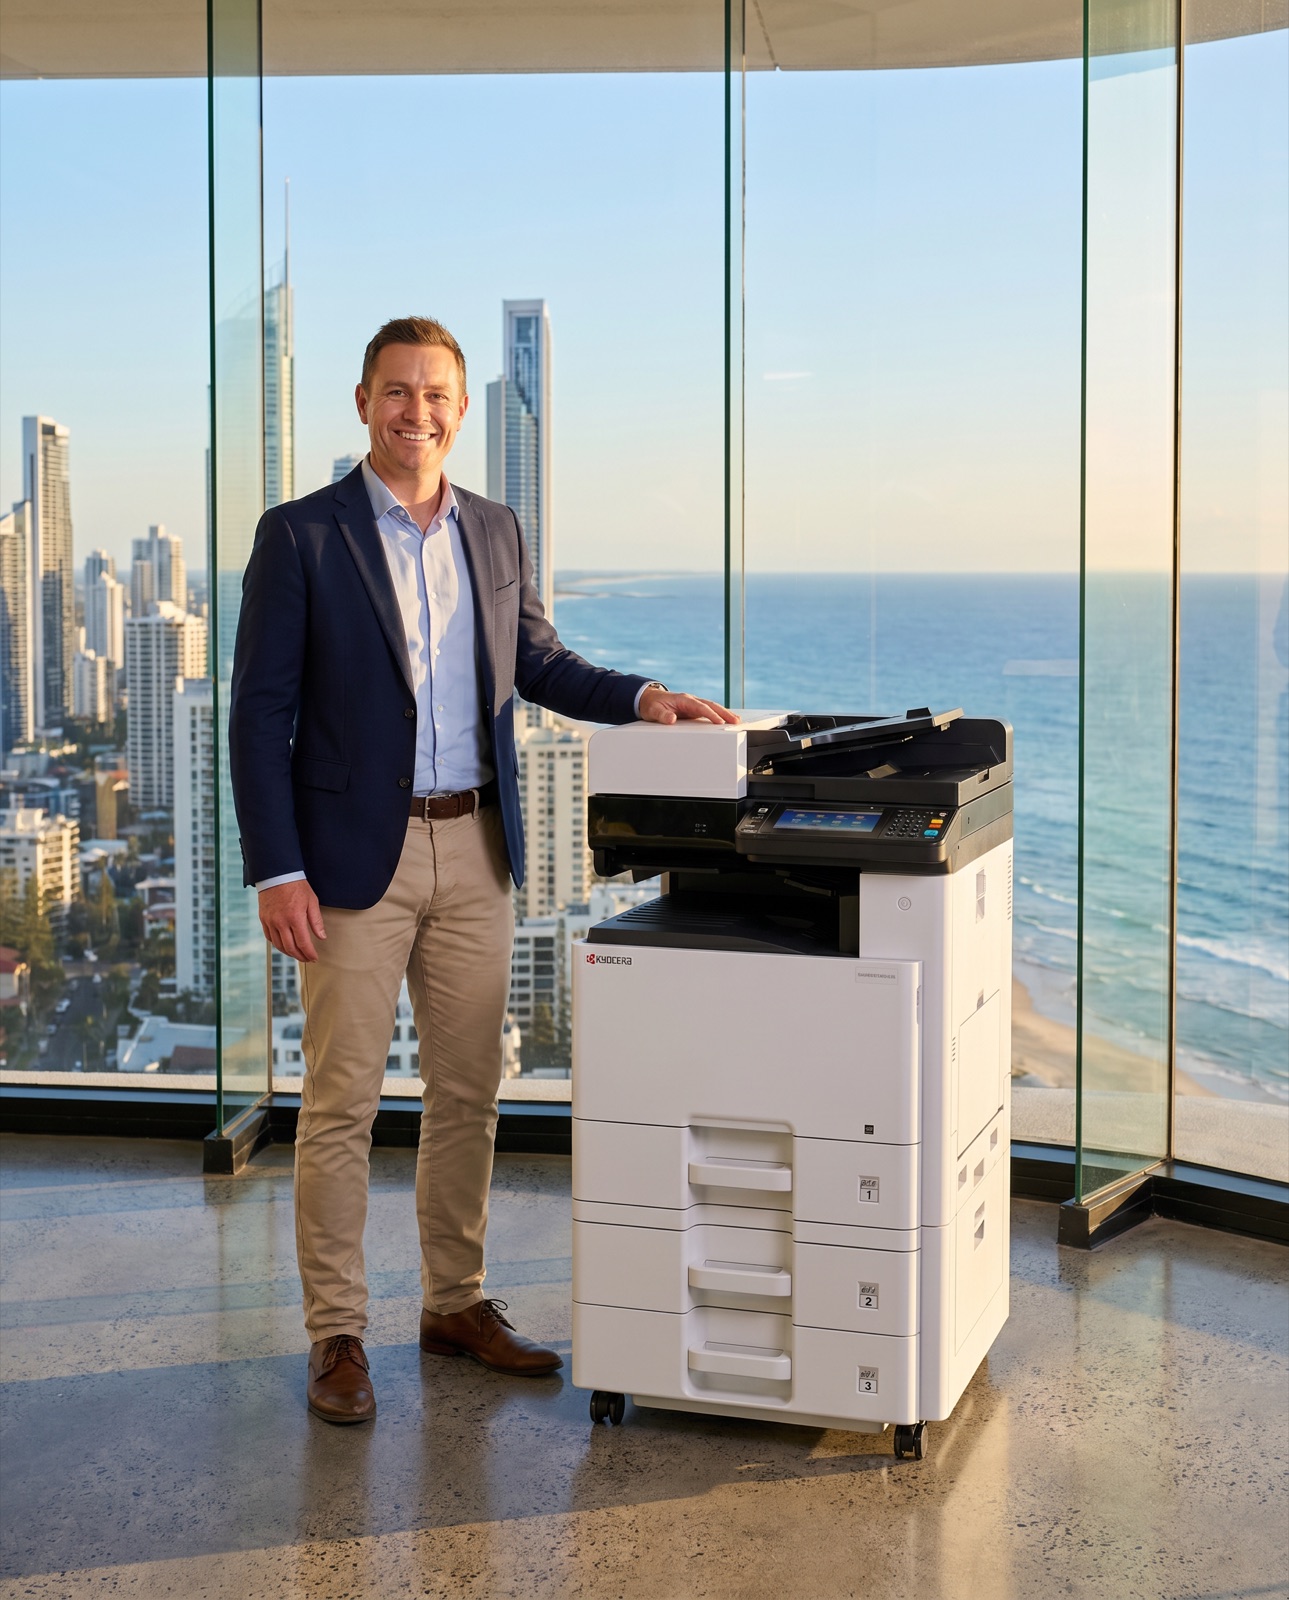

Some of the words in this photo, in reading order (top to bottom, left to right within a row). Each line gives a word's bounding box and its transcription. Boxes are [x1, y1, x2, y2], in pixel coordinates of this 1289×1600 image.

[596, 955, 632, 966] KYOCERA
[866, 1190, 871, 1200] 1
[865, 1296, 873, 1306] 2
[865, 1381, 872, 1391] 3
